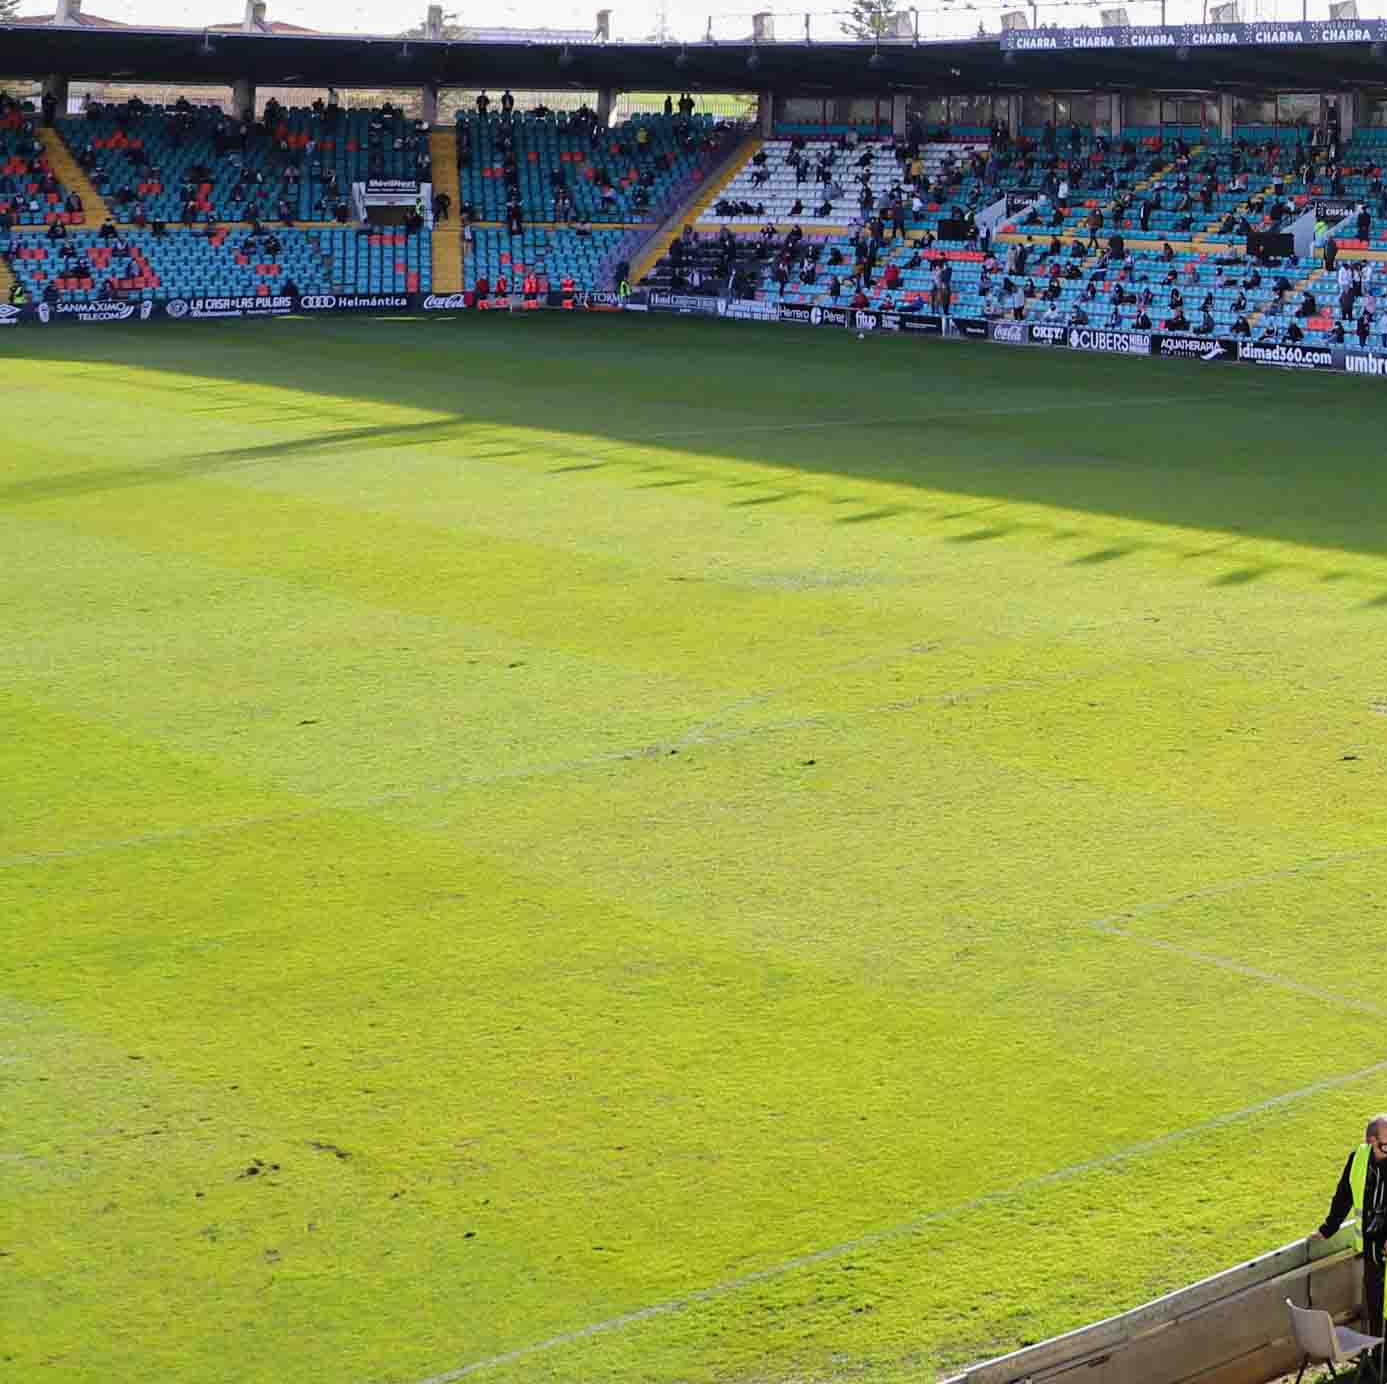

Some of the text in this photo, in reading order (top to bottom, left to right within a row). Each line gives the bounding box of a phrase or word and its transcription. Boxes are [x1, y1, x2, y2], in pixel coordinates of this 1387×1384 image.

[1131, 34, 1175, 46] CHARRA
[1192, 33, 1238, 44] CHARRA
[1256, 31, 1303, 43] CHARRA
[1322, 29, 1371, 41] CHARRA
[1016, 38, 1057, 48] CHARRA
[1073, 36, 1115, 48] CHARRA
[190, 298, 200, 310] LA
[205, 298, 231, 310] CASA
[235, 297, 254, 309] LAS
[256, 296, 292, 308] PULGAS
[338, 296, 408, 308] Helmántica
[1079, 330, 1129, 352] CUBERS
[1239, 342, 1332, 365] idimad360.com
